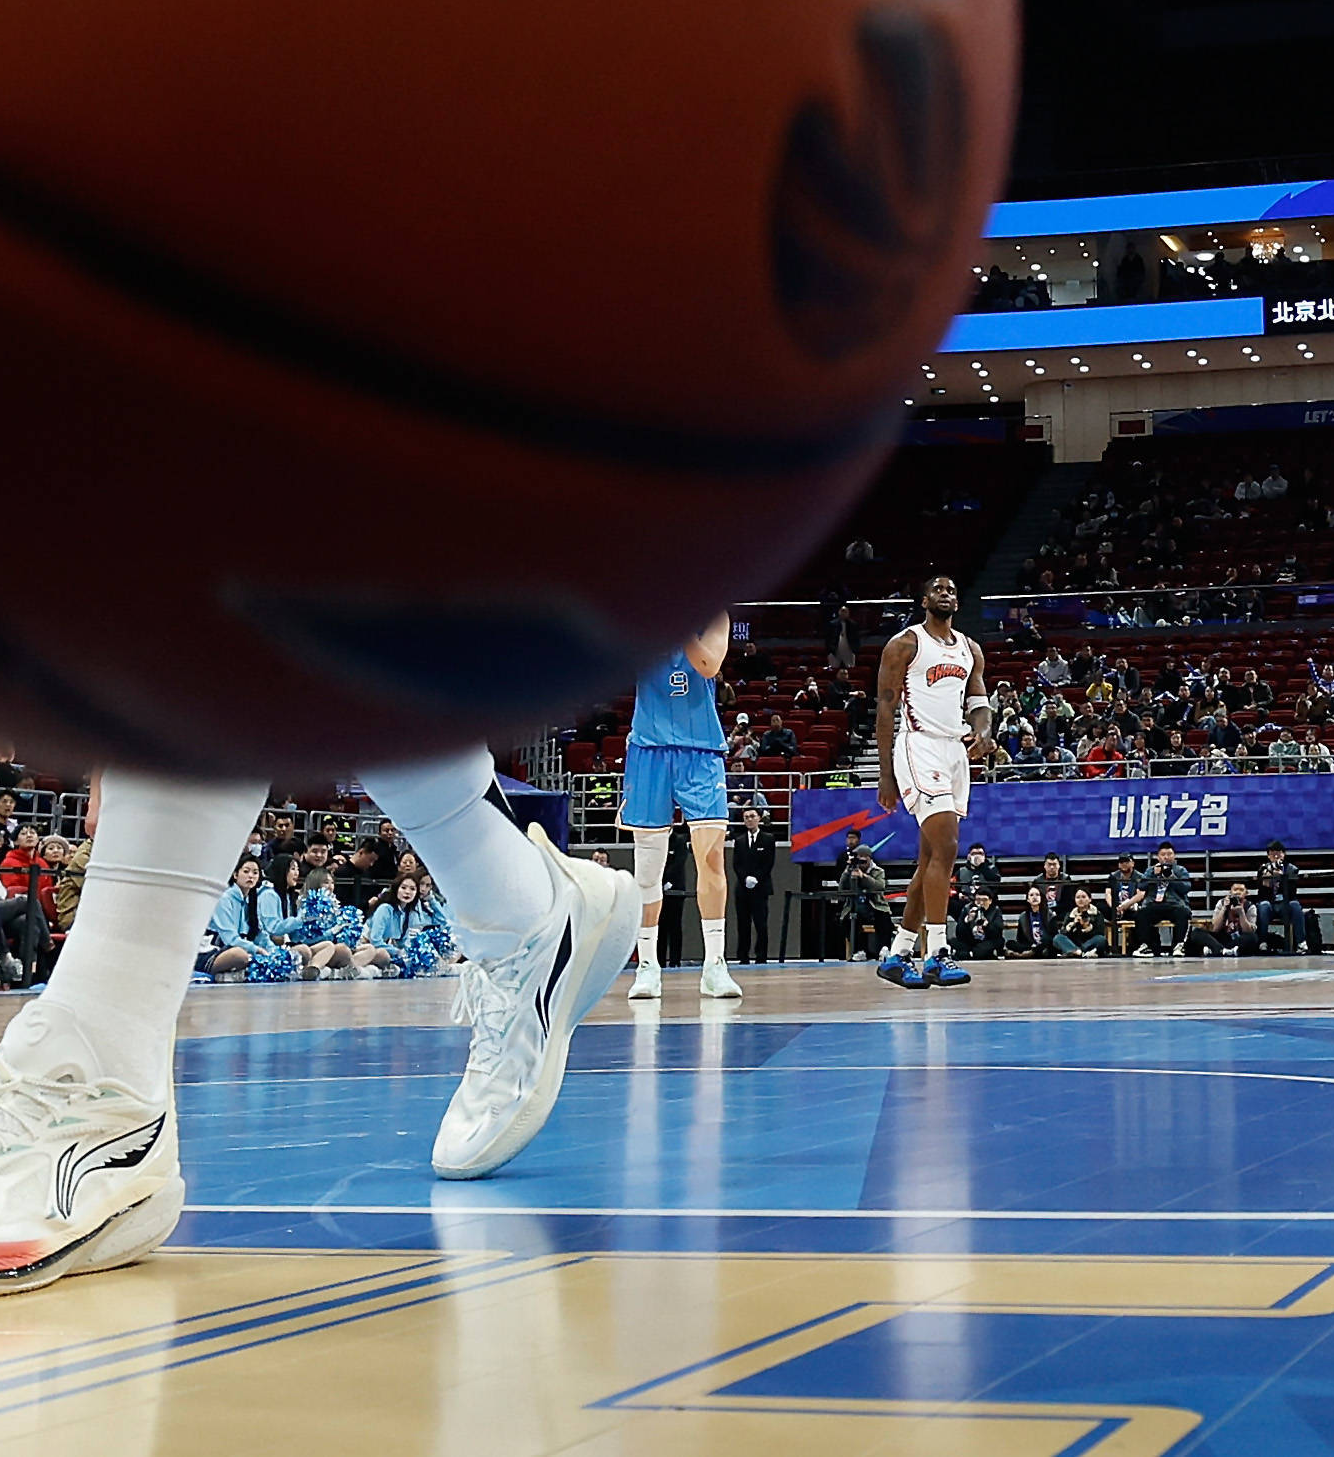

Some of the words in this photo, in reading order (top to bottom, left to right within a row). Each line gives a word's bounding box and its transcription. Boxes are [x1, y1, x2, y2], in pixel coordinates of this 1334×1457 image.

[670, 671, 689, 697] 9
[1109, 793, 1228, 839] 以城之名
